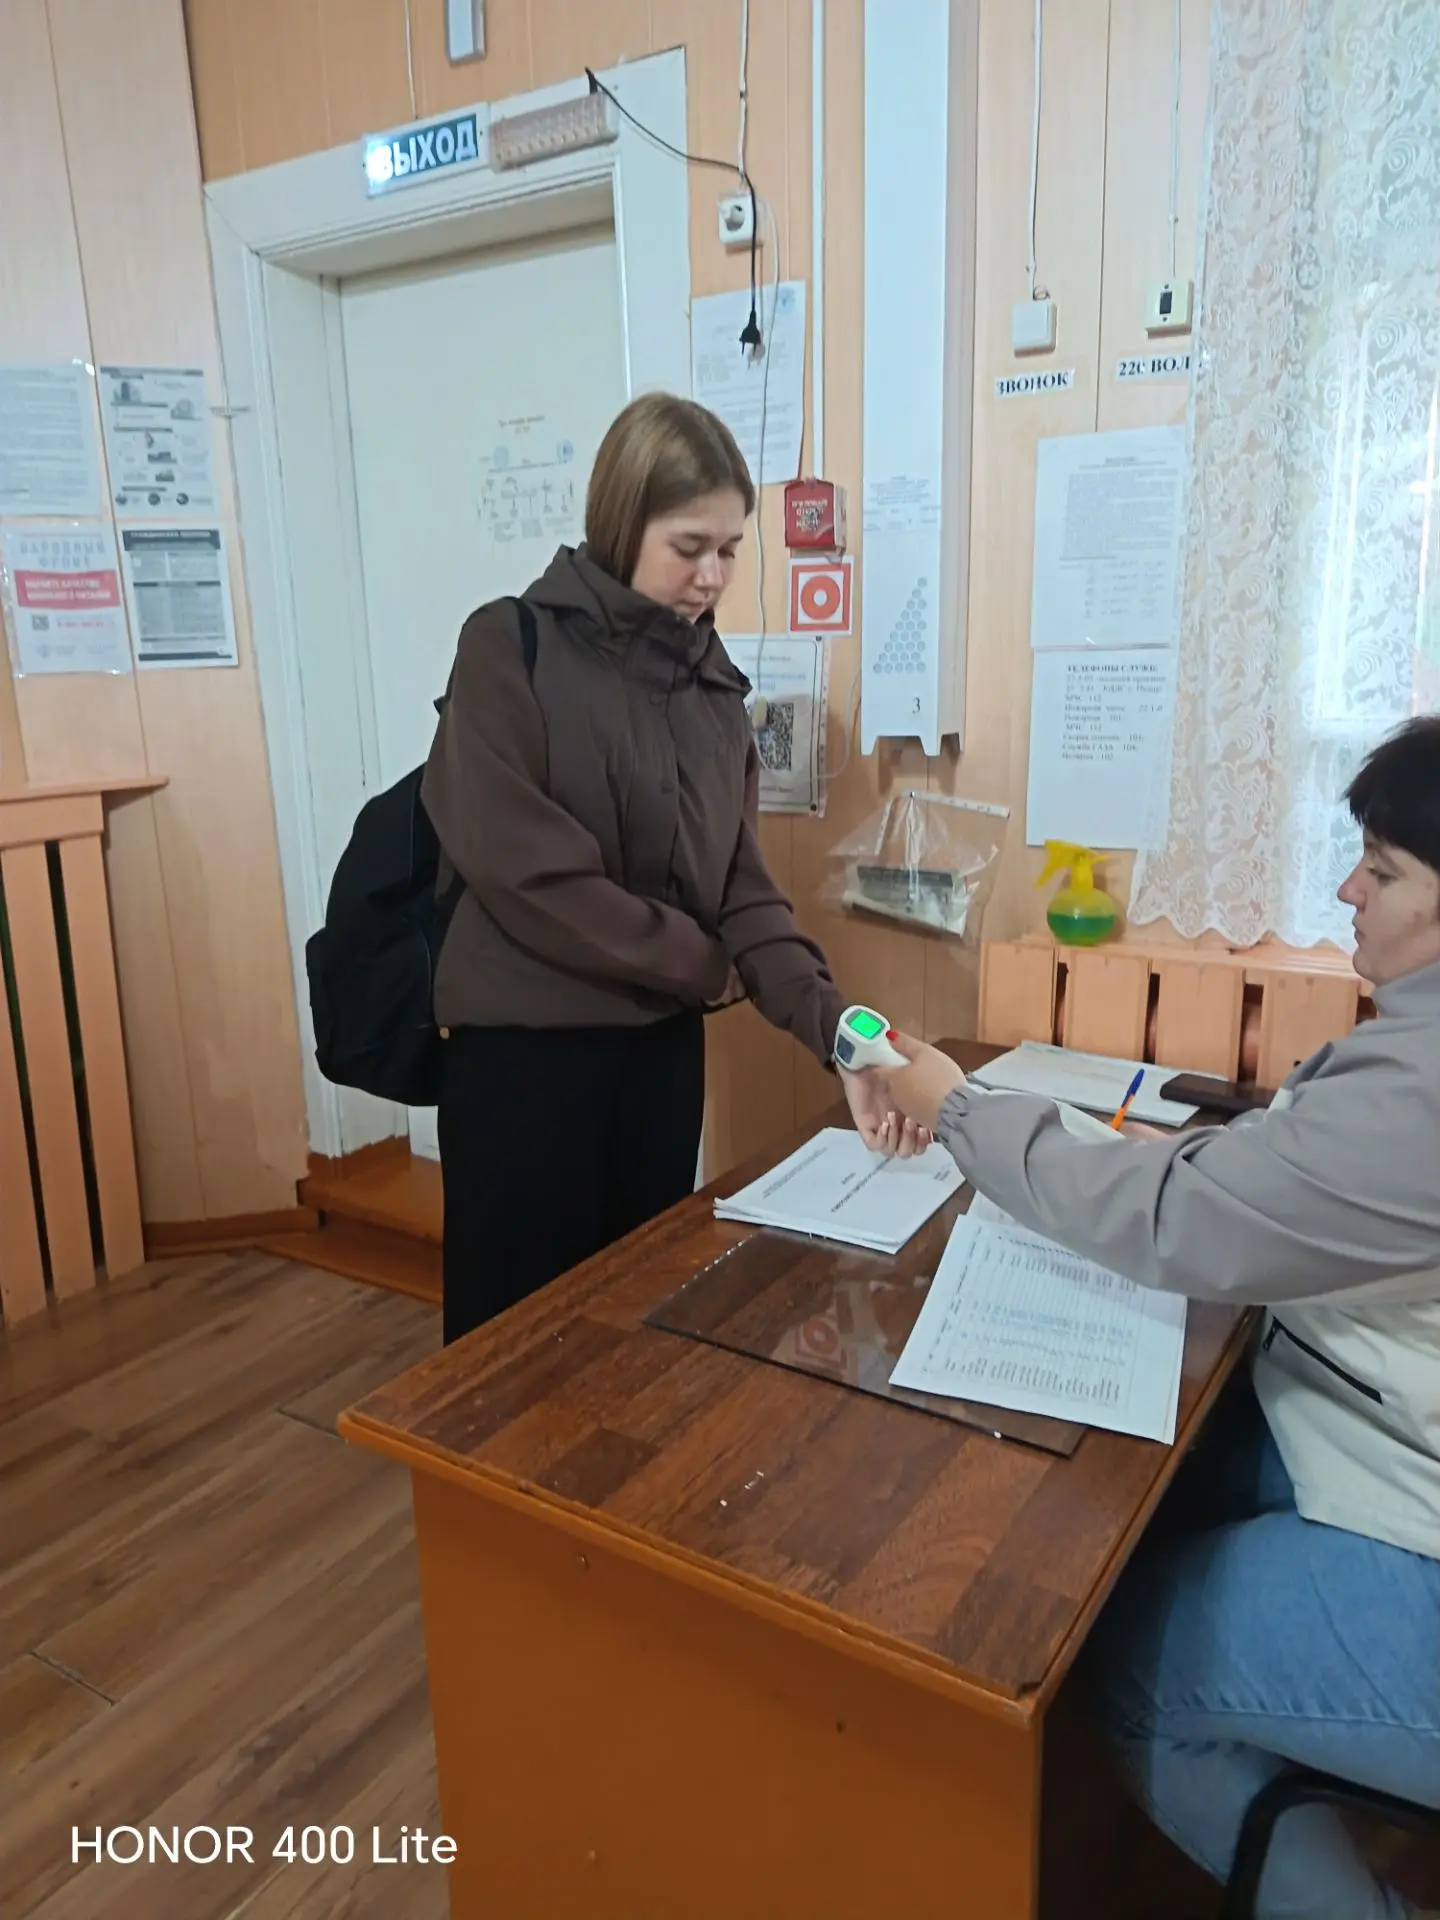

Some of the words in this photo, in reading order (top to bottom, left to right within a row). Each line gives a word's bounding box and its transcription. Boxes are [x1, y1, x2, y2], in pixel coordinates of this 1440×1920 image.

[367, 119, 477, 182] ВЫХОД
[997, 371, 1069, 395] ЗВОНОК
[911, 696, 921, 714] 3
